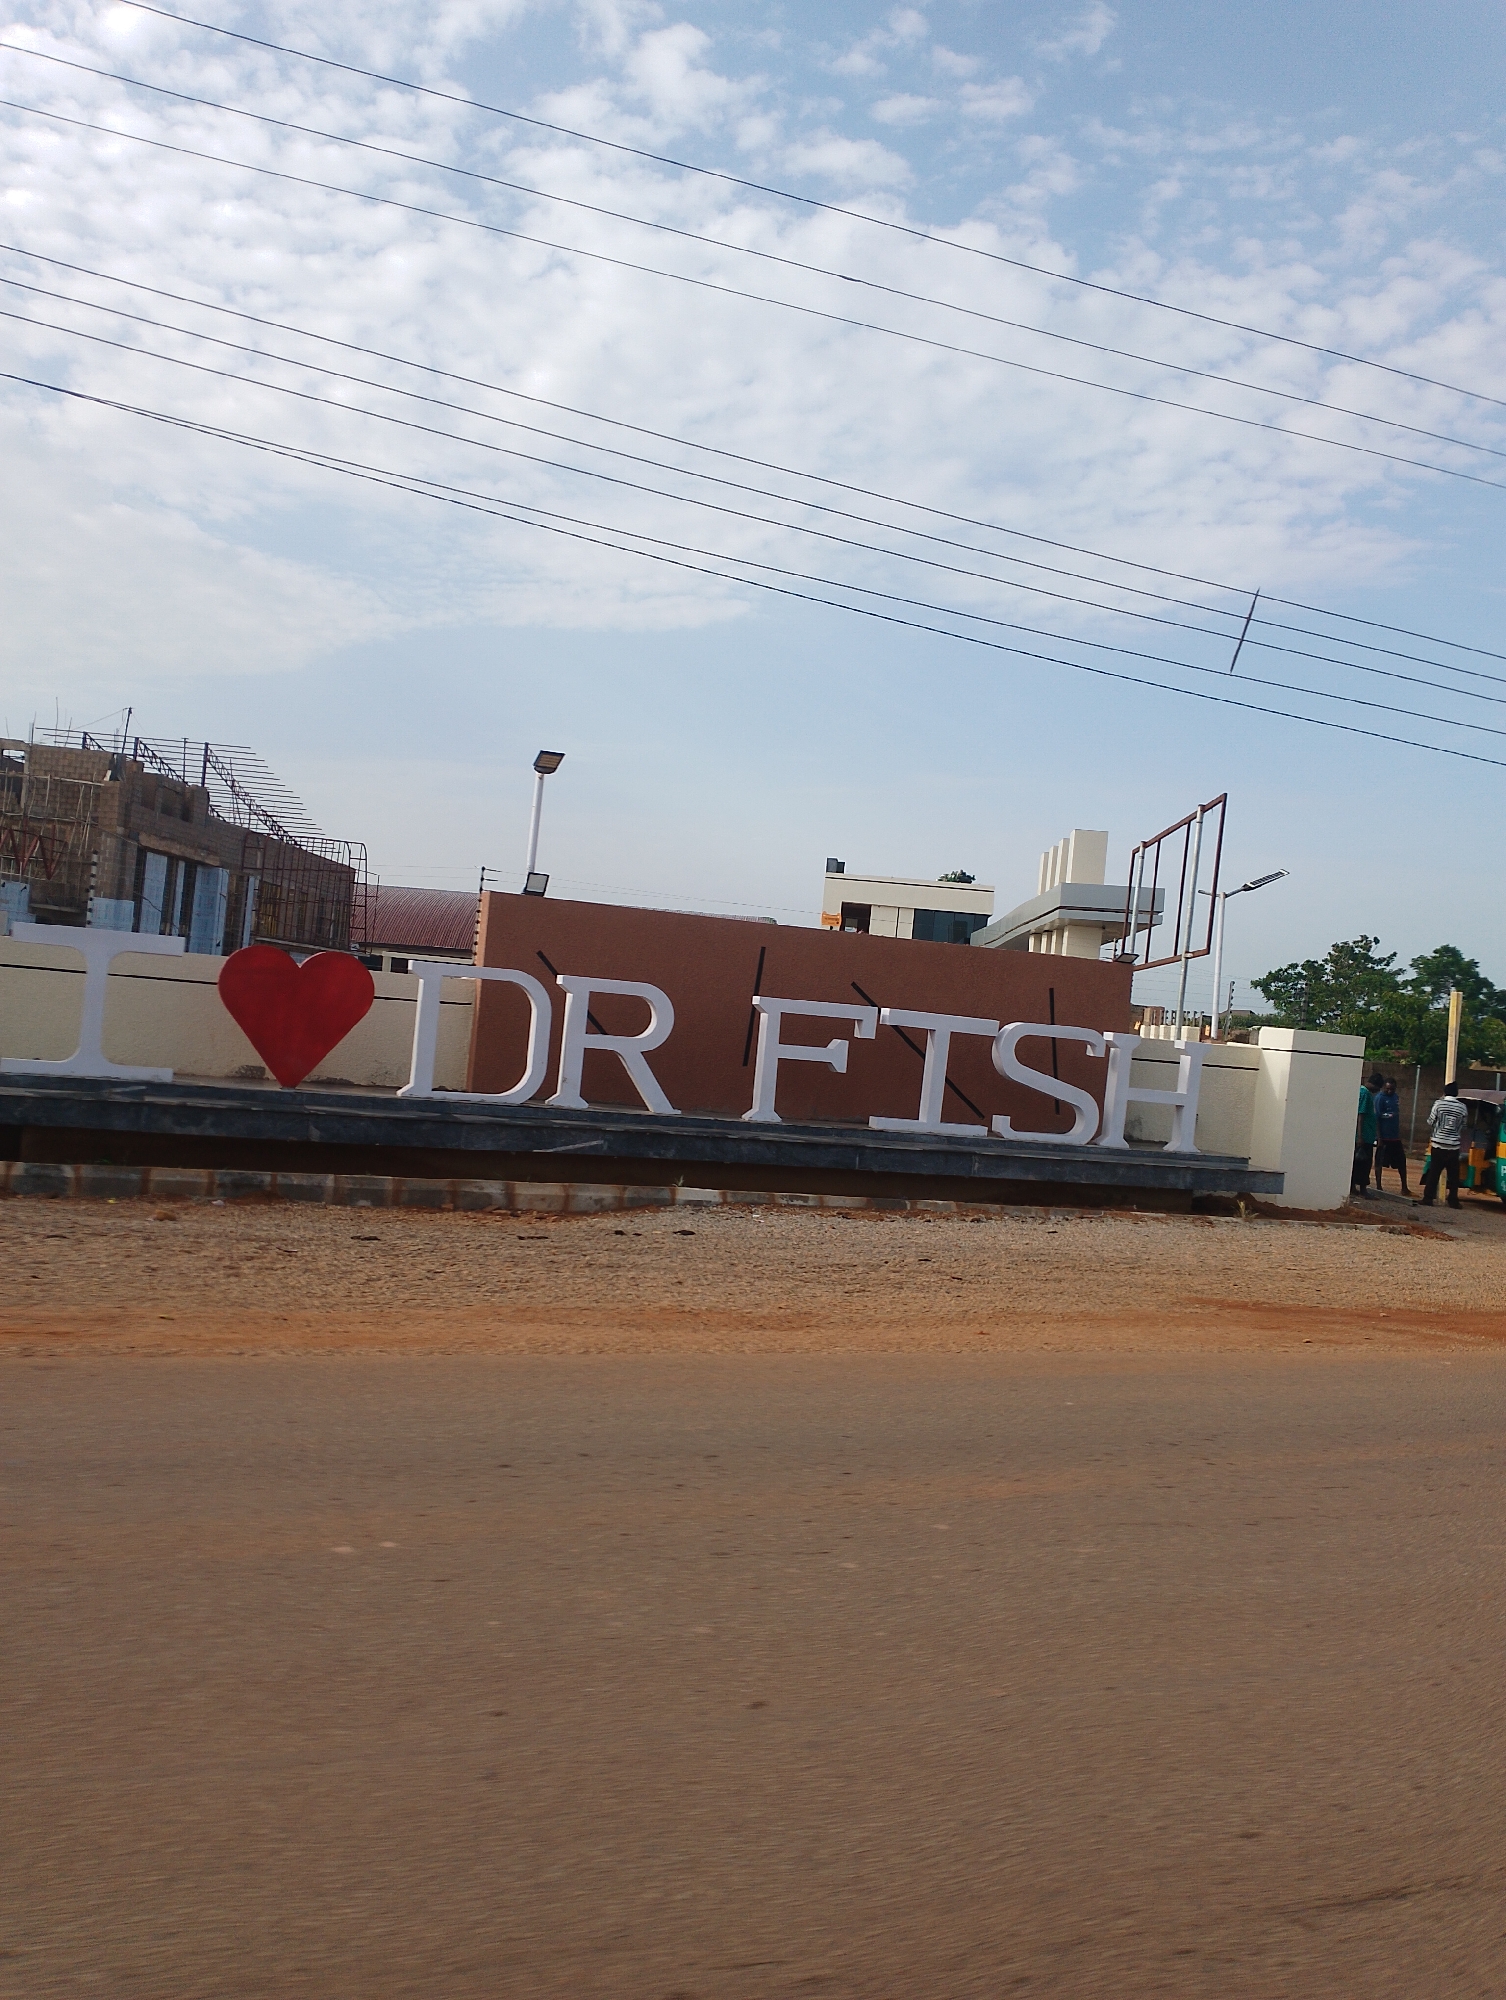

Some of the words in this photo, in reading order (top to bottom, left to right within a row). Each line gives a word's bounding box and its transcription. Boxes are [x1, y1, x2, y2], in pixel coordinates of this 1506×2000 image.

[0, 921, 185, 1083] I
[396, 958, 683, 1115] DR
[741, 995, 1211, 1153] FISH
